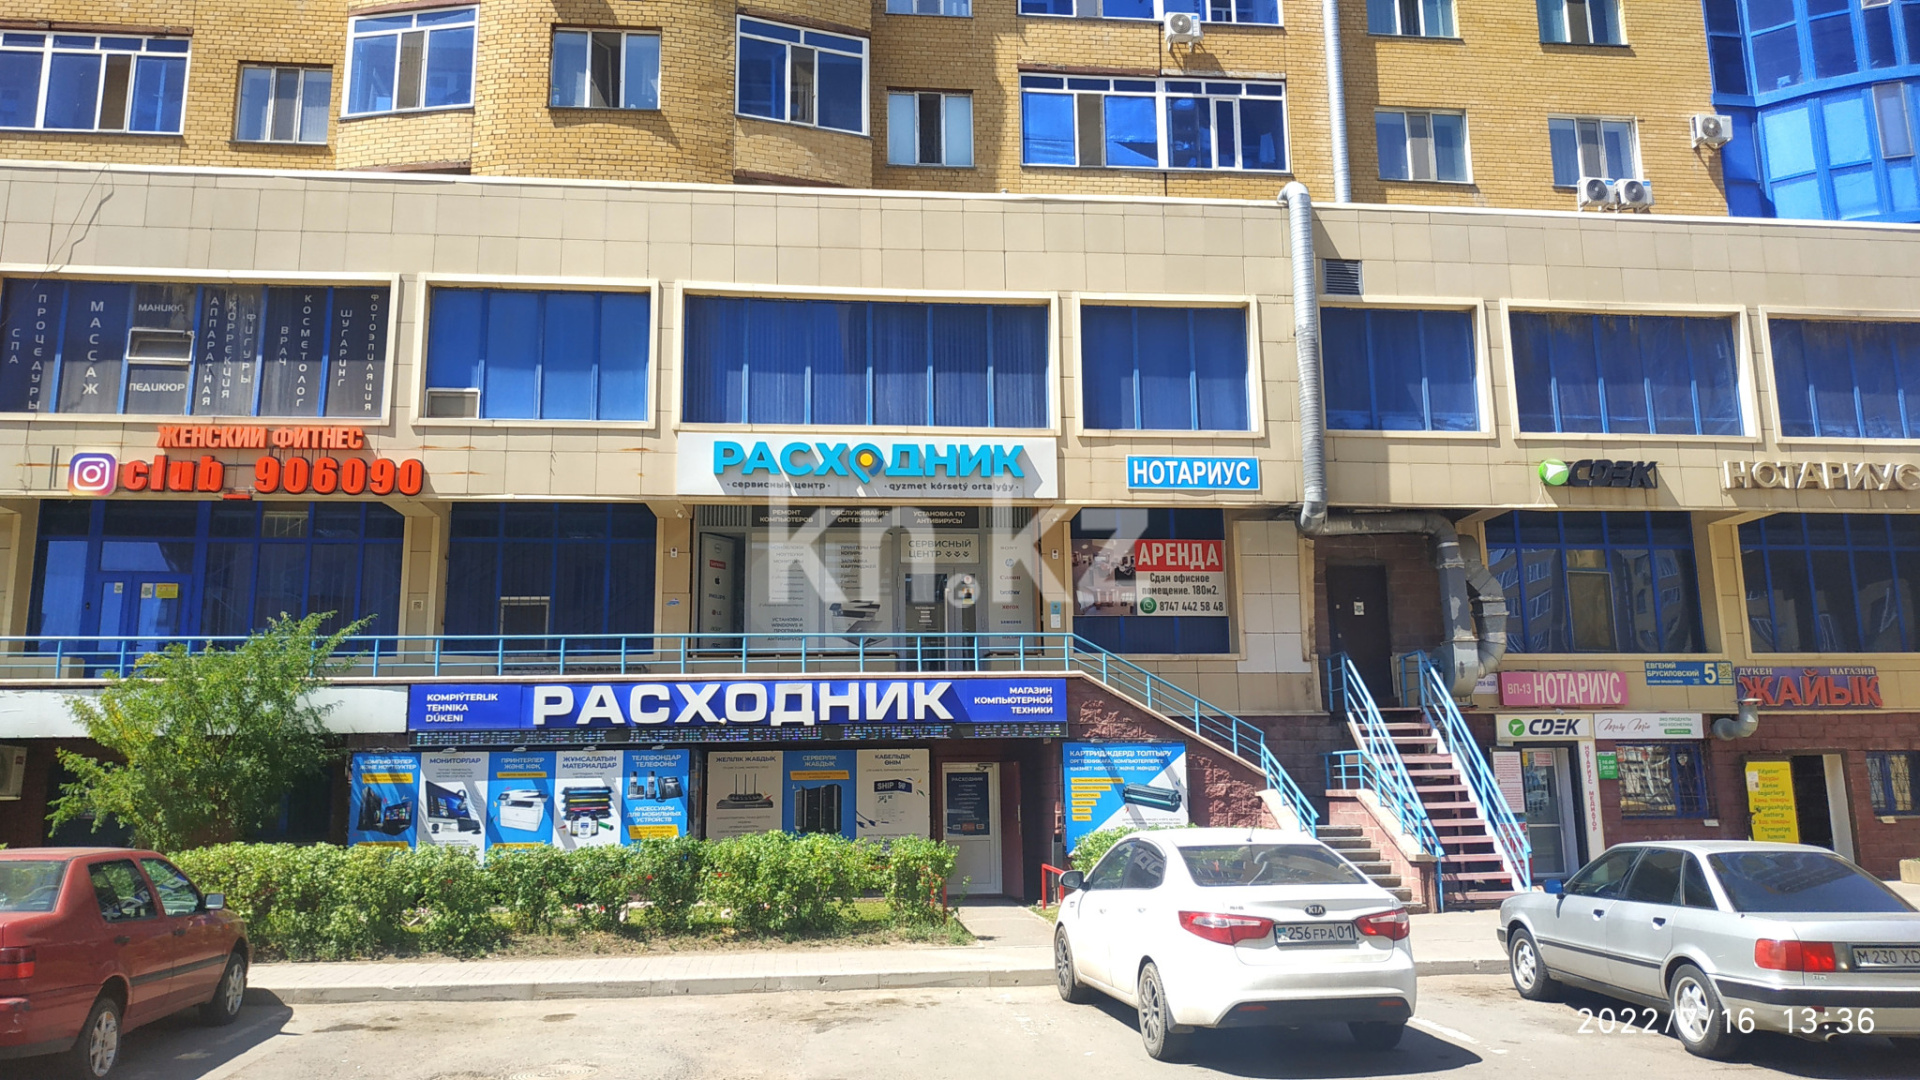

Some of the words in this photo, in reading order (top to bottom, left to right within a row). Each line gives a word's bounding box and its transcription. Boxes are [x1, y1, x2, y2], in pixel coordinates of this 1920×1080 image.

[8, 328, 21, 364] СПА
[28, 294, 47, 410] ПРОЦЕДУРЫ
[82, 301, 104, 395] МАССАЖ
[202, 297, 219, 406] АППАРАТНАЯ
[221, 301, 237, 398] КОРРЕКЦИЯ
[240, 314, 256, 384] ФИГУРЫ
[279, 326, 289, 366] ВРАЧ
[296, 295, 312, 407] КОСМЕТОЛОГ
[338, 309, 352, 387] ШУГАРИНГ
[364, 294, 379, 411] ФОТОЭПИЛЯЦИЯ
[129, 383, 186, 392] ПЕДИКЮР
[157, 425, 267, 449] ЖЕНСКИЙ
[272, 427, 364, 450] ФИТНЕС
[713, 441, 1024, 484] РАСХОДНИК
[1133, 460, 1251, 486] НОТАРИУС
[732, 481, 789, 490] сервисный
[794, 482, 826, 490] центр
[889, 482, 927, 491] qyzmet
[908, 538, 972, 548] СЕРВИСНЫЙ
[908, 550, 942, 559] ЦЕНТР
[1137, 542, 1220, 570] АРЕНДА
[1150, 573, 1171, 583] Сдам
[1173, 573, 1210, 584] офисное
[1159, 601, 1179, 611] 8747
[1181, 601, 1197, 611] 442
[1200, 601, 1211, 611] 58
[1213, 601, 1224, 611] 48
[1646, 661, 1676, 669] ЕВГЕНИЙ
[1647, 669, 1700, 677] БРУСИЛОВСКИЙ
[1704, 663, 1717, 684] 5
[1830, 667, 1876, 676] МАГАЗИН
[427, 691, 498, 702] KOMPIÝTERLIK
[1507, 683, 1531, 695] ВП-13
[1533, 672, 1622, 704] НОТАРИУС
[426, 703, 469, 712] TEHNIKA
[533, 682, 955, 726] РАСХОДНИК
[974, 695, 1053, 704] КОМПЬЮТЕРНОЙ
[1011, 706, 1053, 714] ТЕХНИКИ
[1528, 718, 1581, 735] CDEK
[1584, 745, 1593, 785] НОТАРИУС
[877, 782, 894, 790] SHIP
[1308, 905, 1325, 915] KIA
[1288, 924, 1312, 940] 256
[1314, 928, 1335, 940] FPA
[1337, 924, 1352, 940] 01
[1856, 951, 1869, 962] M
[1871, 951, 1897, 963] 230
